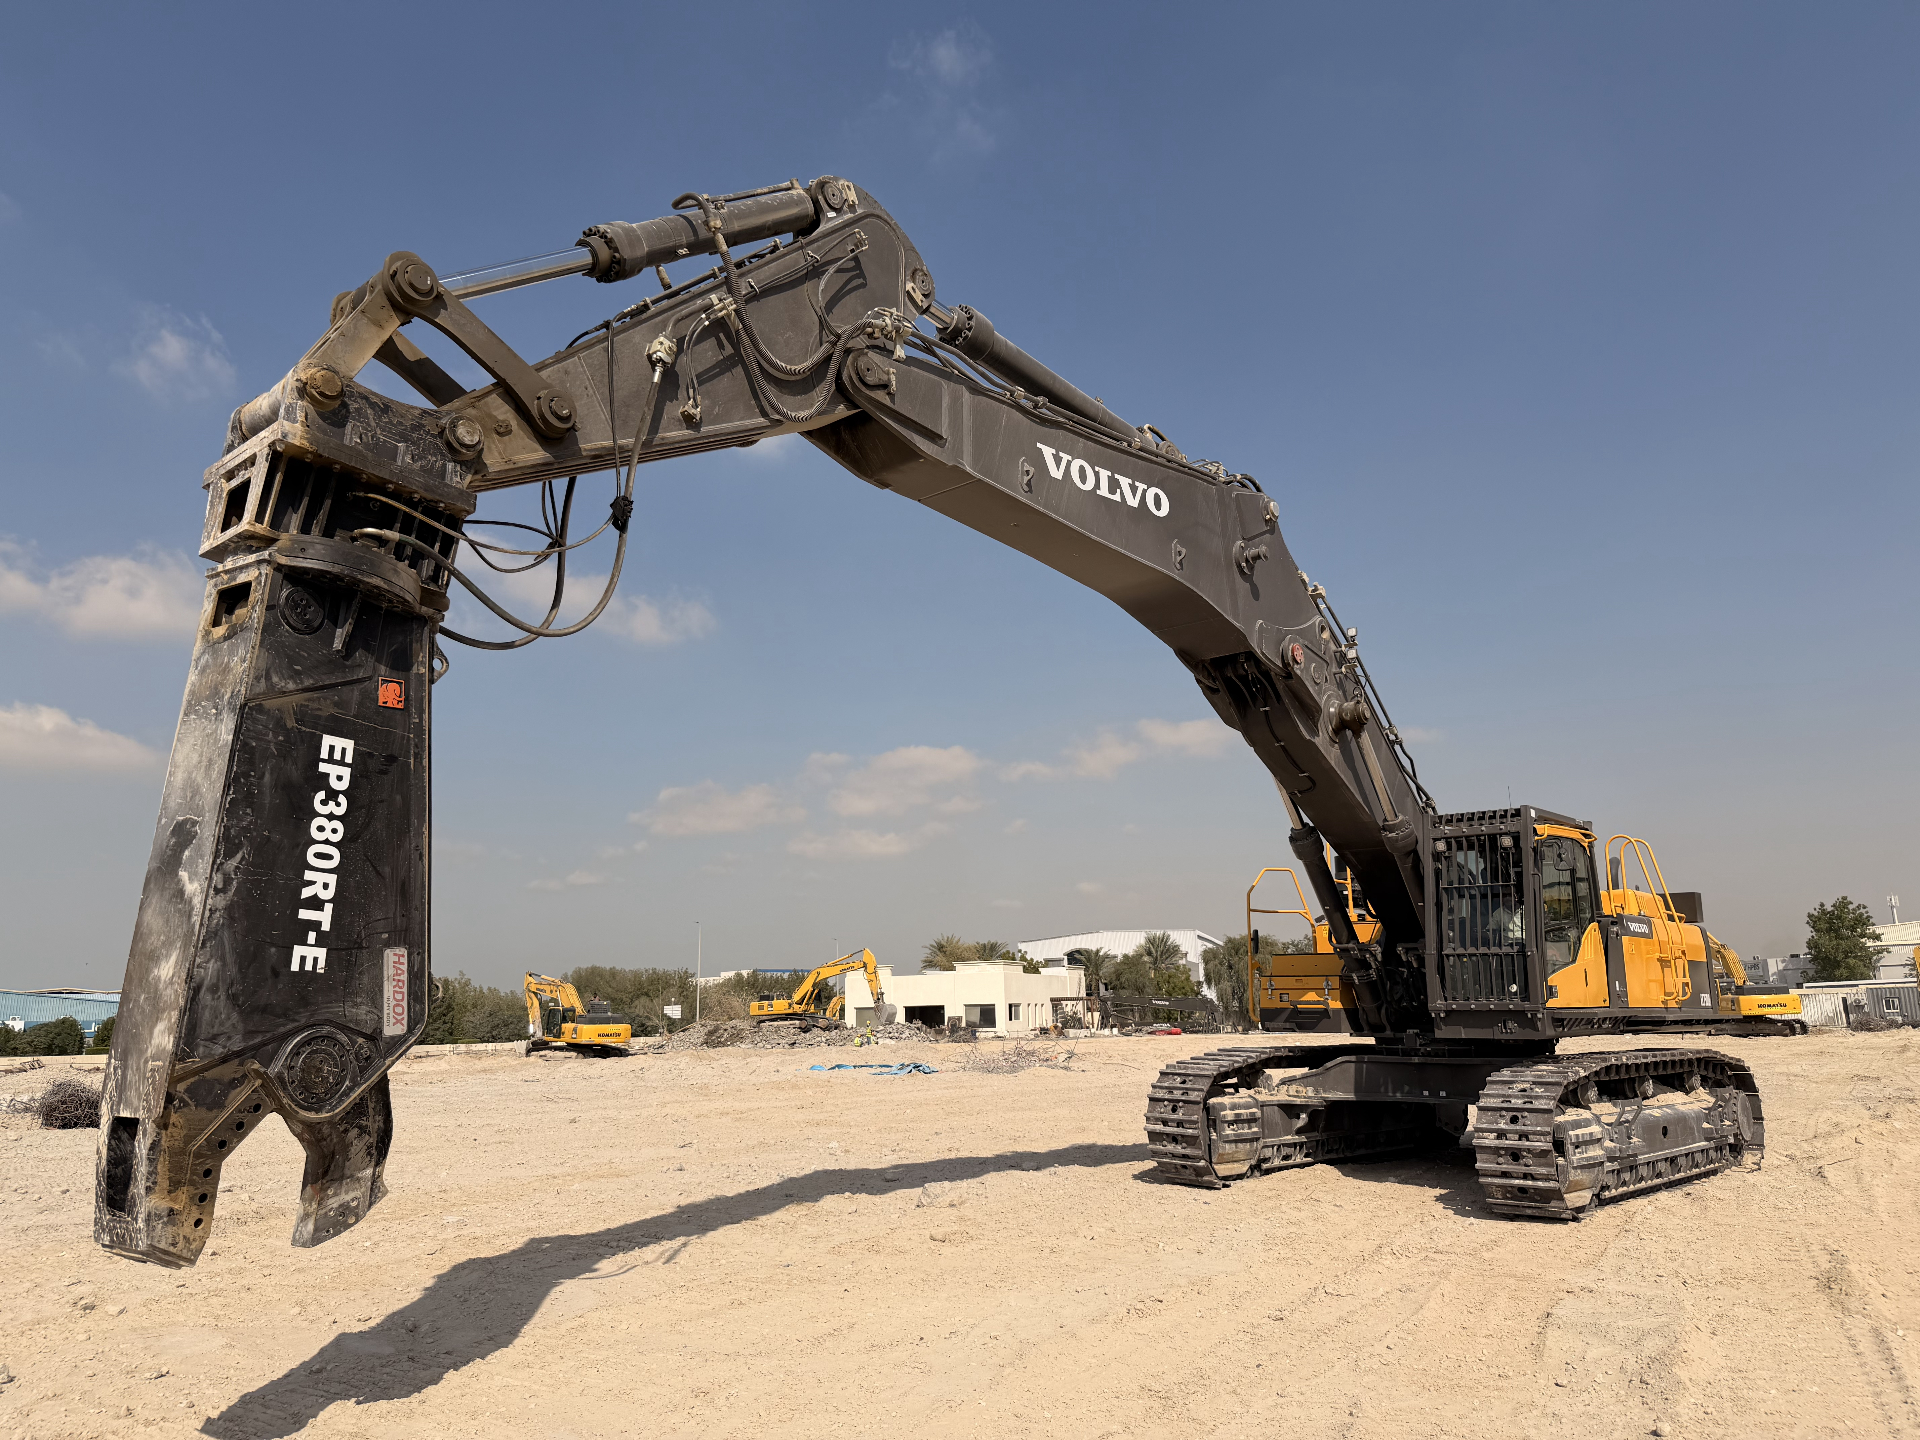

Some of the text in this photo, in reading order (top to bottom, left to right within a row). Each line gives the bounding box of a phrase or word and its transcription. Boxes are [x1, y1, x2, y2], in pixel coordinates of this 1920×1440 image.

[1036, 442, 1169, 517] VOLVO
[291, 734, 354, 973] EP380RT-E
[1628, 922, 1648, 933] VOLVO
[393, 953, 405, 1027] HARDOX
